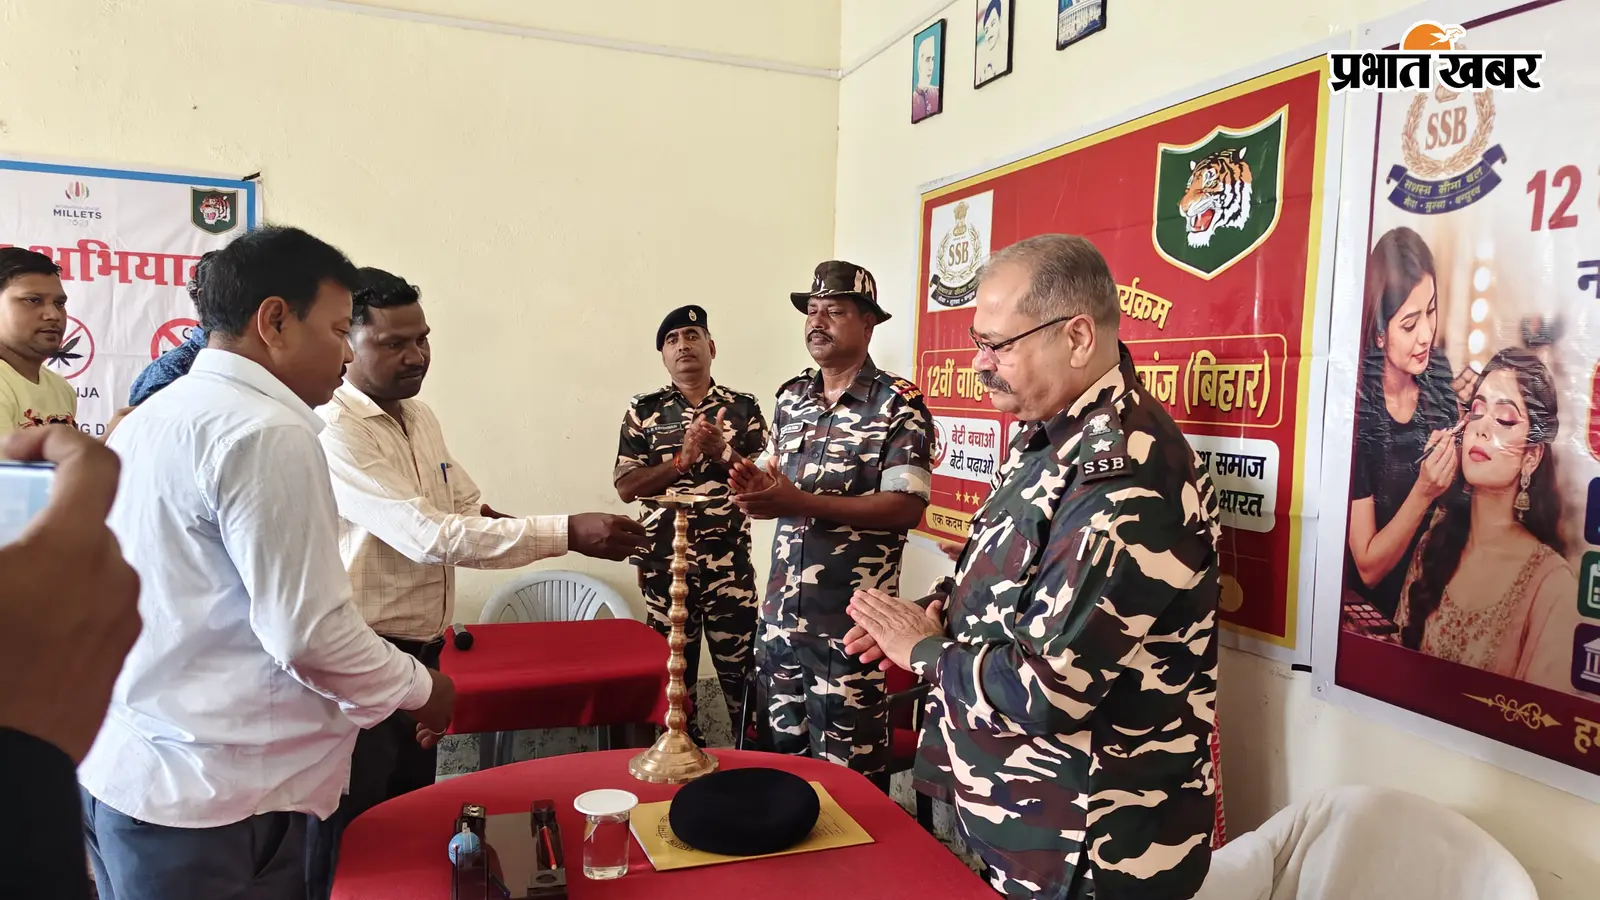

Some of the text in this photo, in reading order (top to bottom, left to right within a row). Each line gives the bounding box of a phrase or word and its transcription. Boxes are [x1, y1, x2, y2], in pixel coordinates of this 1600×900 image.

[1424, 106, 1468, 150] SSB
[1526, 164, 1582, 232] 12
[53, 208, 102, 220] MILLETS
[948, 241, 969, 267] SSB
[1115, 277, 1173, 330] र्यक्रम
[927, 358, 955, 398] 12वीं
[1135, 350, 1180, 406] गंज
[1183, 349, 1271, 418] (बिहार)
[951, 424, 996, 449] बेटी बचाओ
[949, 449, 994, 477] बेटी पढ़ाओ
[1083, 457, 1125, 475] SSB
[1215, 452, 1267, 480] समाज
[1218, 488, 1265, 518] भारत
[932, 512, 944, 527] एक
[945, 514, 963, 531] कदम
